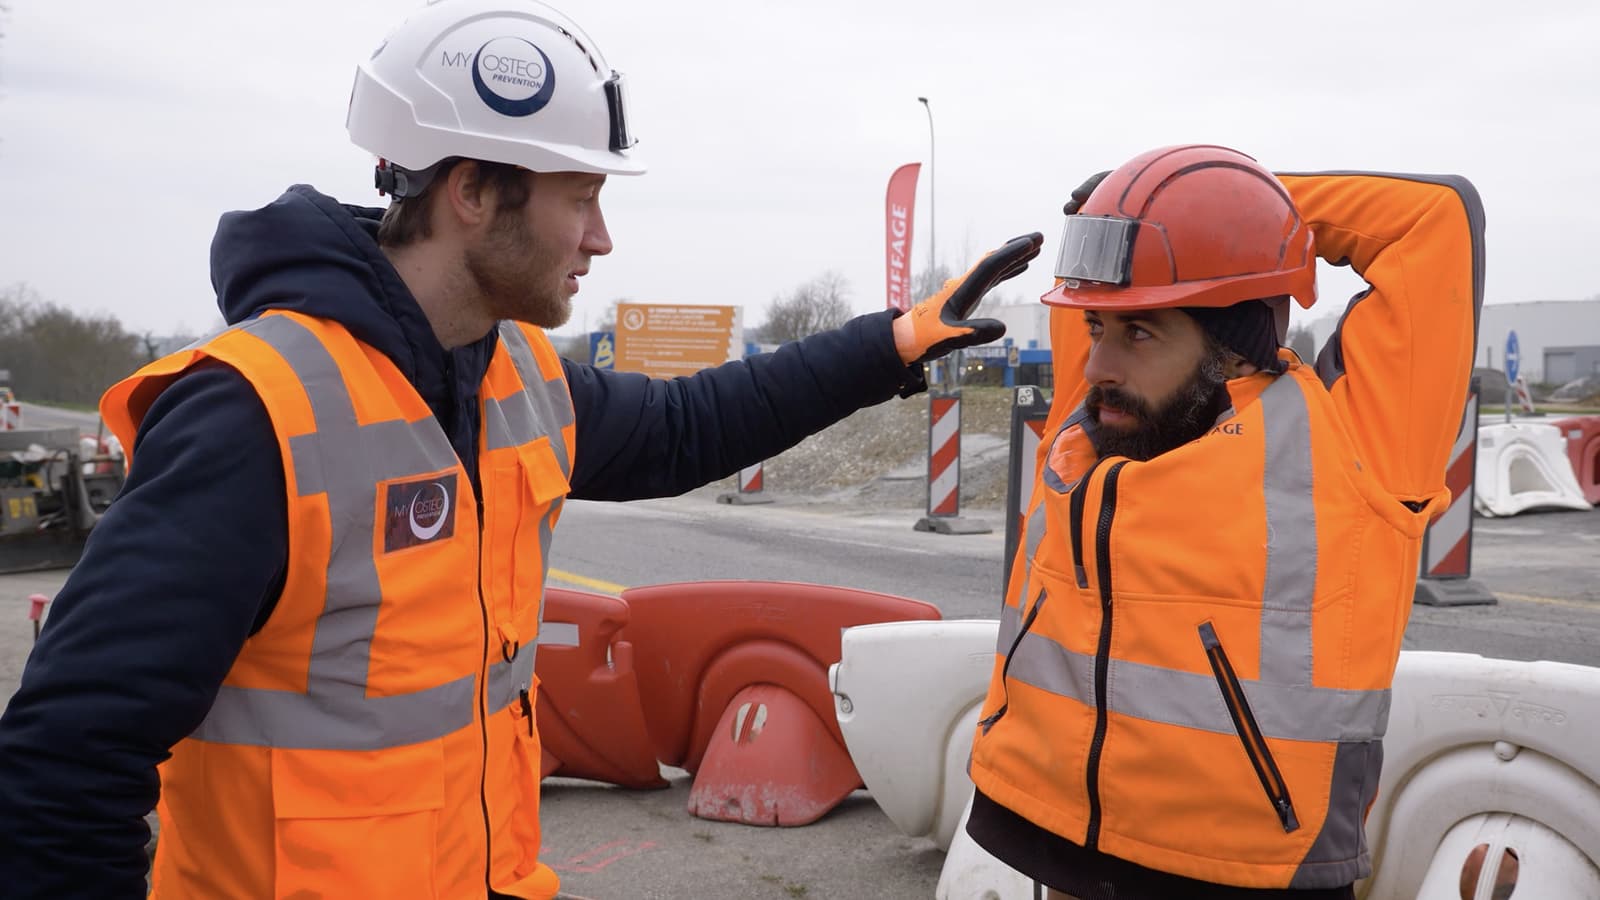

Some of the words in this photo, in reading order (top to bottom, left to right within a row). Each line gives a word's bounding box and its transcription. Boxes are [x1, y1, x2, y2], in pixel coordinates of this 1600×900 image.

[441, 50, 472, 68] MY
[482, 54, 542, 79] OSTEO
[492, 73, 542, 89] PREVENTION
[889, 203, 907, 307] EIFFAGE
[394, 504, 410, 518] MY
[415, 498, 443, 514] OSTEO
